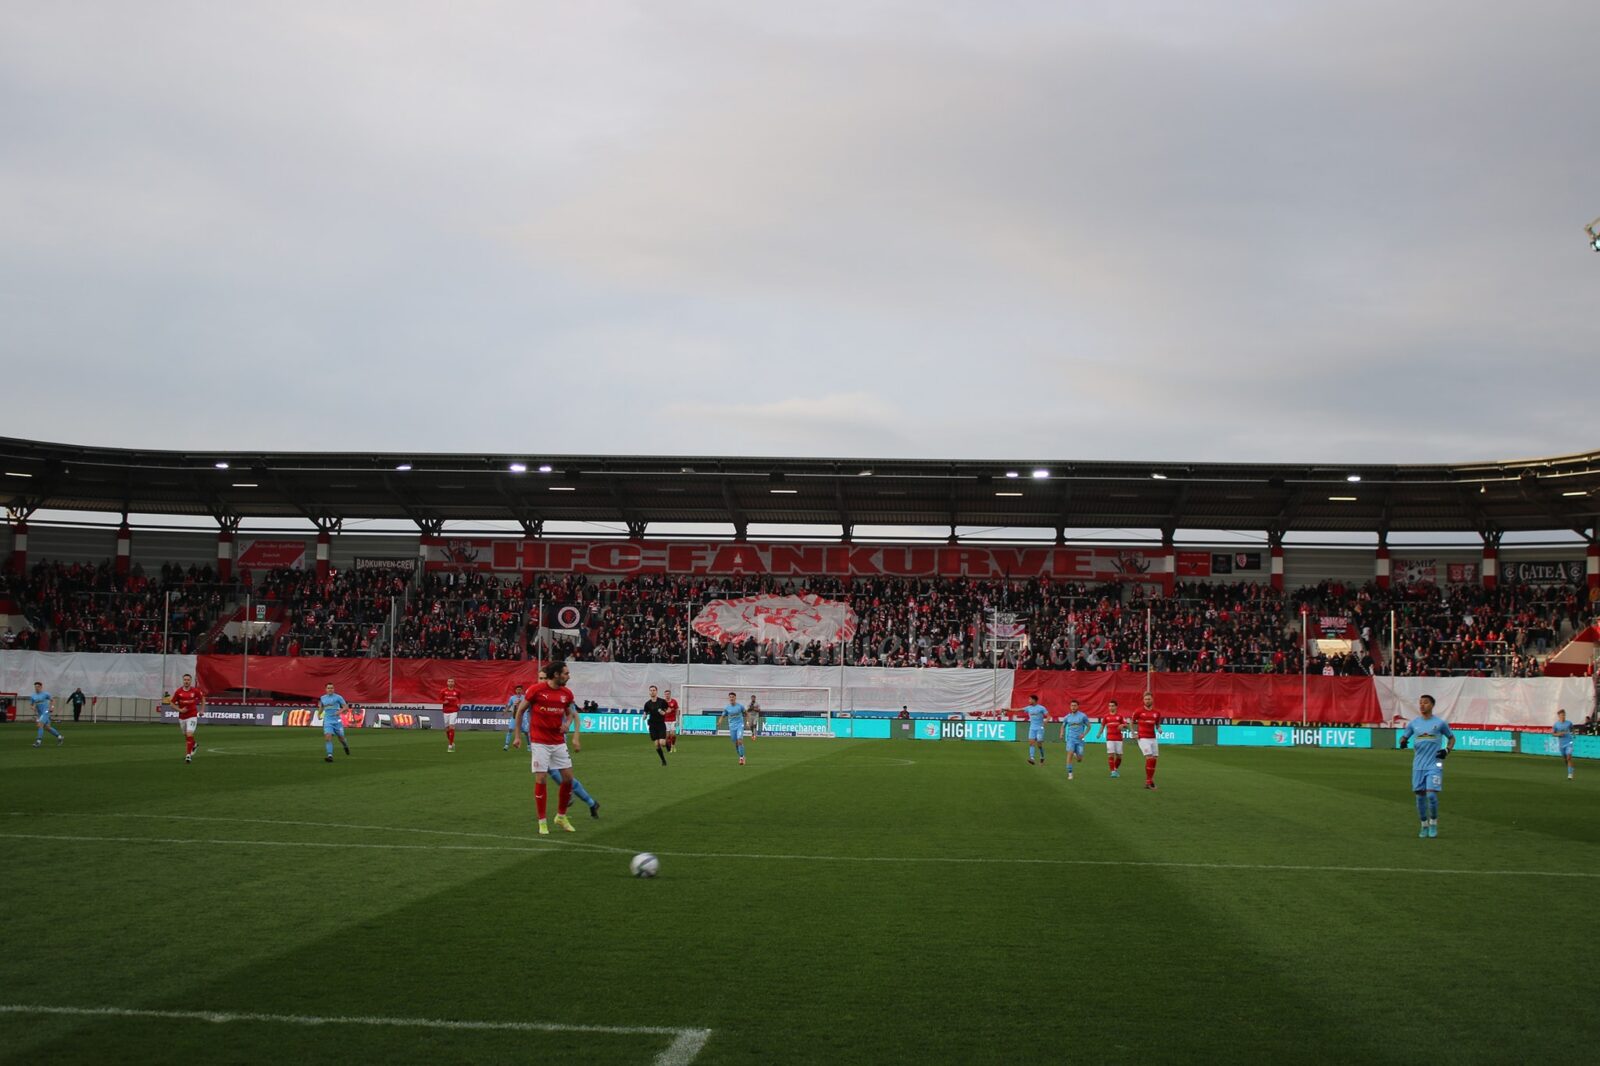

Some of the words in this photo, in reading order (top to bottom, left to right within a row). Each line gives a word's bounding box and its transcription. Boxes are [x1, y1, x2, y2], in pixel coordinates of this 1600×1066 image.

[600, 715, 629, 731] HIGH
[762, 721, 826, 733] Karrierechancen
[942, 722, 973, 738] HIGH
[976, 723, 1005, 739] FIVE
[1291, 729, 1322, 745] HIGH
[1326, 730, 1355, 746] FIVE
